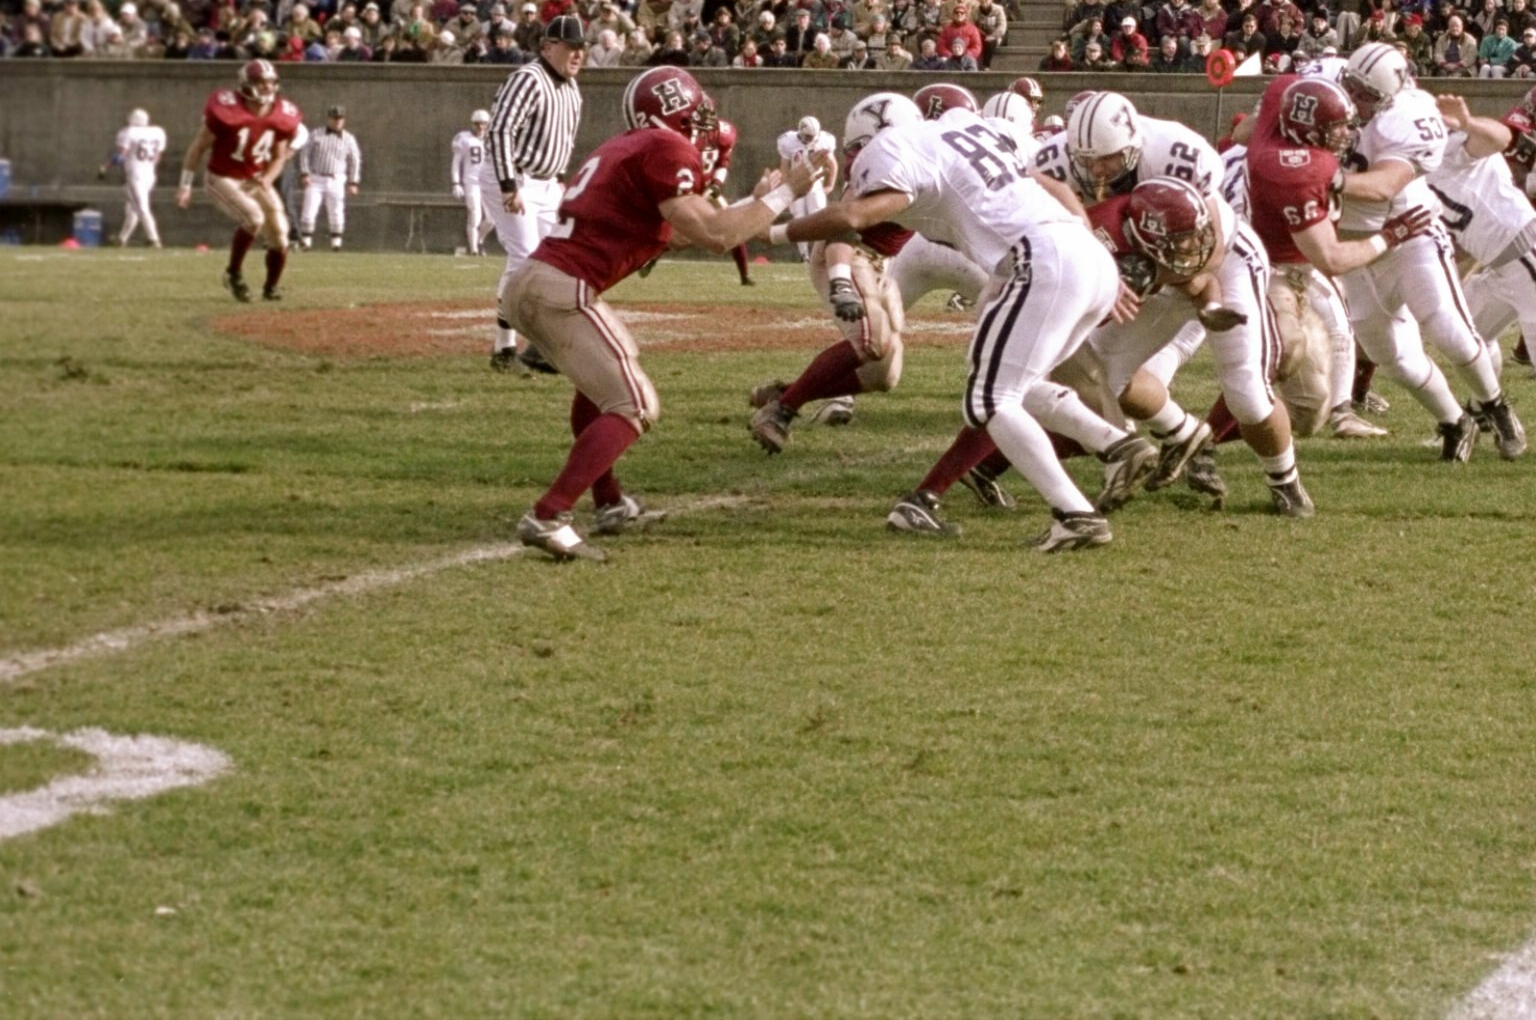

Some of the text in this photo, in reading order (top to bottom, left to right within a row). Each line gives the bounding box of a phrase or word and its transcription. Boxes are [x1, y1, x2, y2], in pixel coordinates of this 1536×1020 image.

[651, 77, 691, 117] H
[1289, 92, 1319, 126] H
[636, 112, 650, 129] 2
[862, 99, 893, 130] Y
[230, 127, 275, 164] 14
[941, 123, 1030, 192] 83
[677, 168, 695, 195] 2
